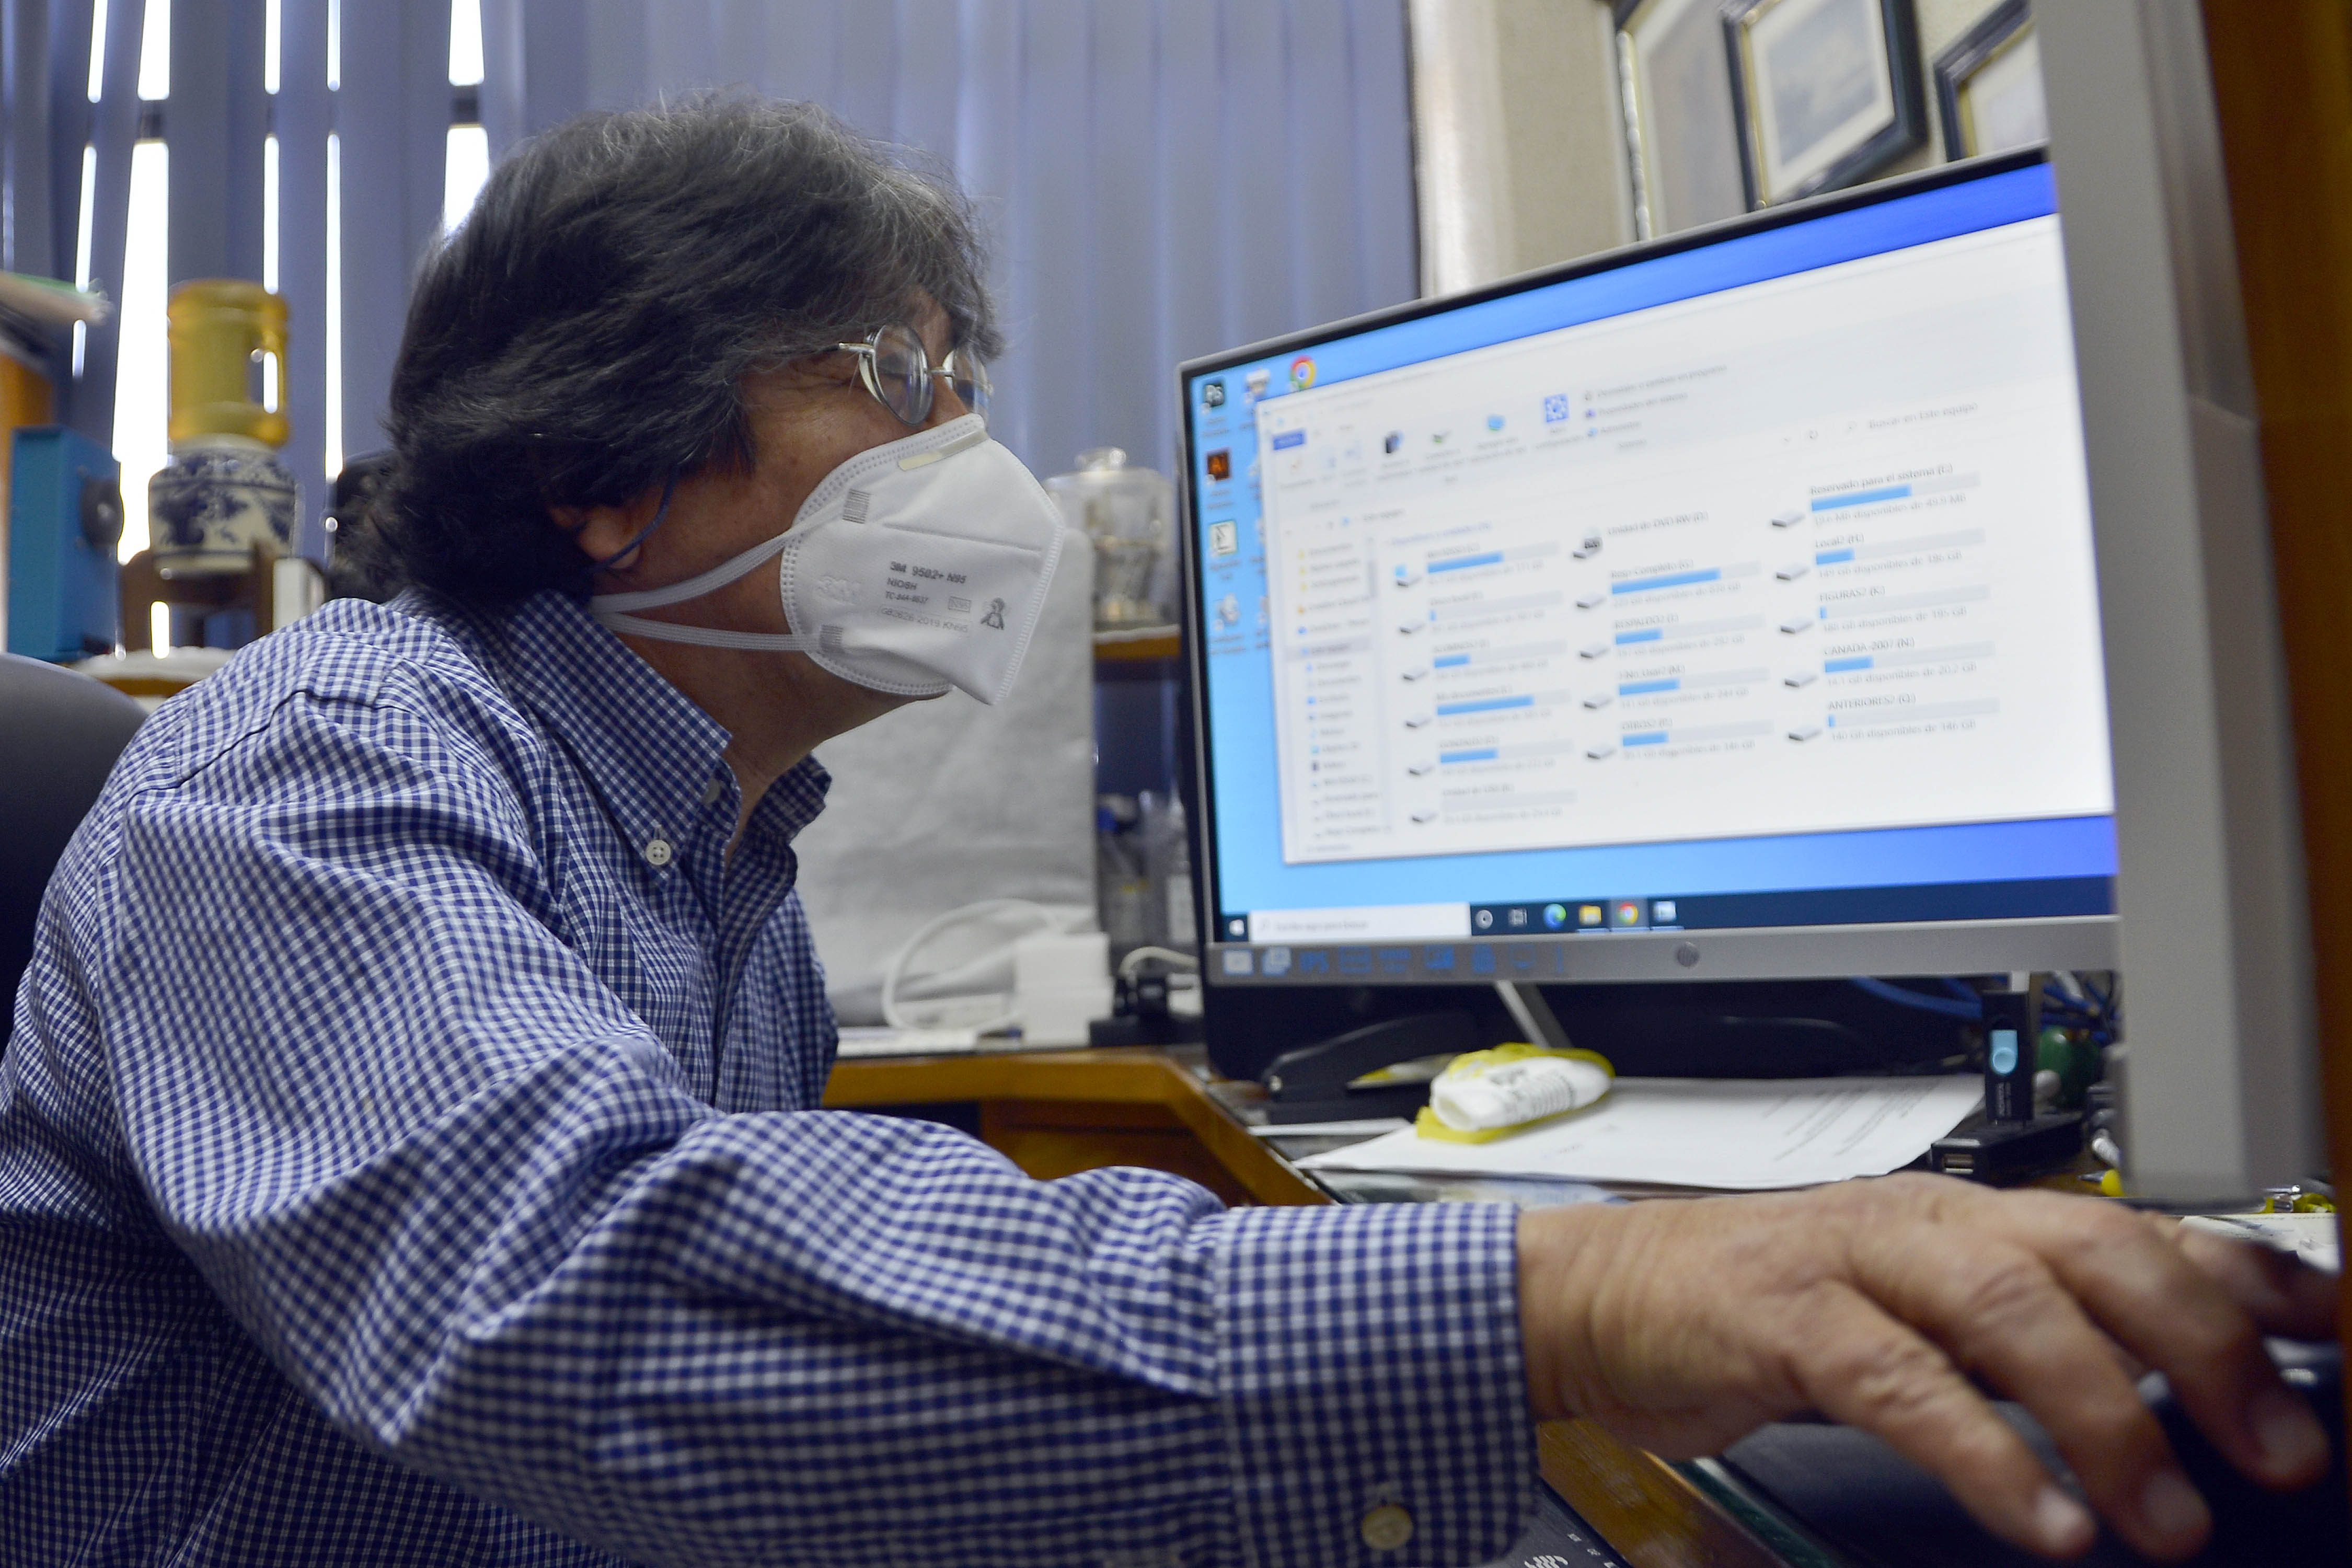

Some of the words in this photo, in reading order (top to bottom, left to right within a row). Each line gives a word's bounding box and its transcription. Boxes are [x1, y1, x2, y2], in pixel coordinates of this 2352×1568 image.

[890, 561, 907, 573] 3M
[946, 573, 967, 584] N95
[886, 577, 918, 590] NIOSH
